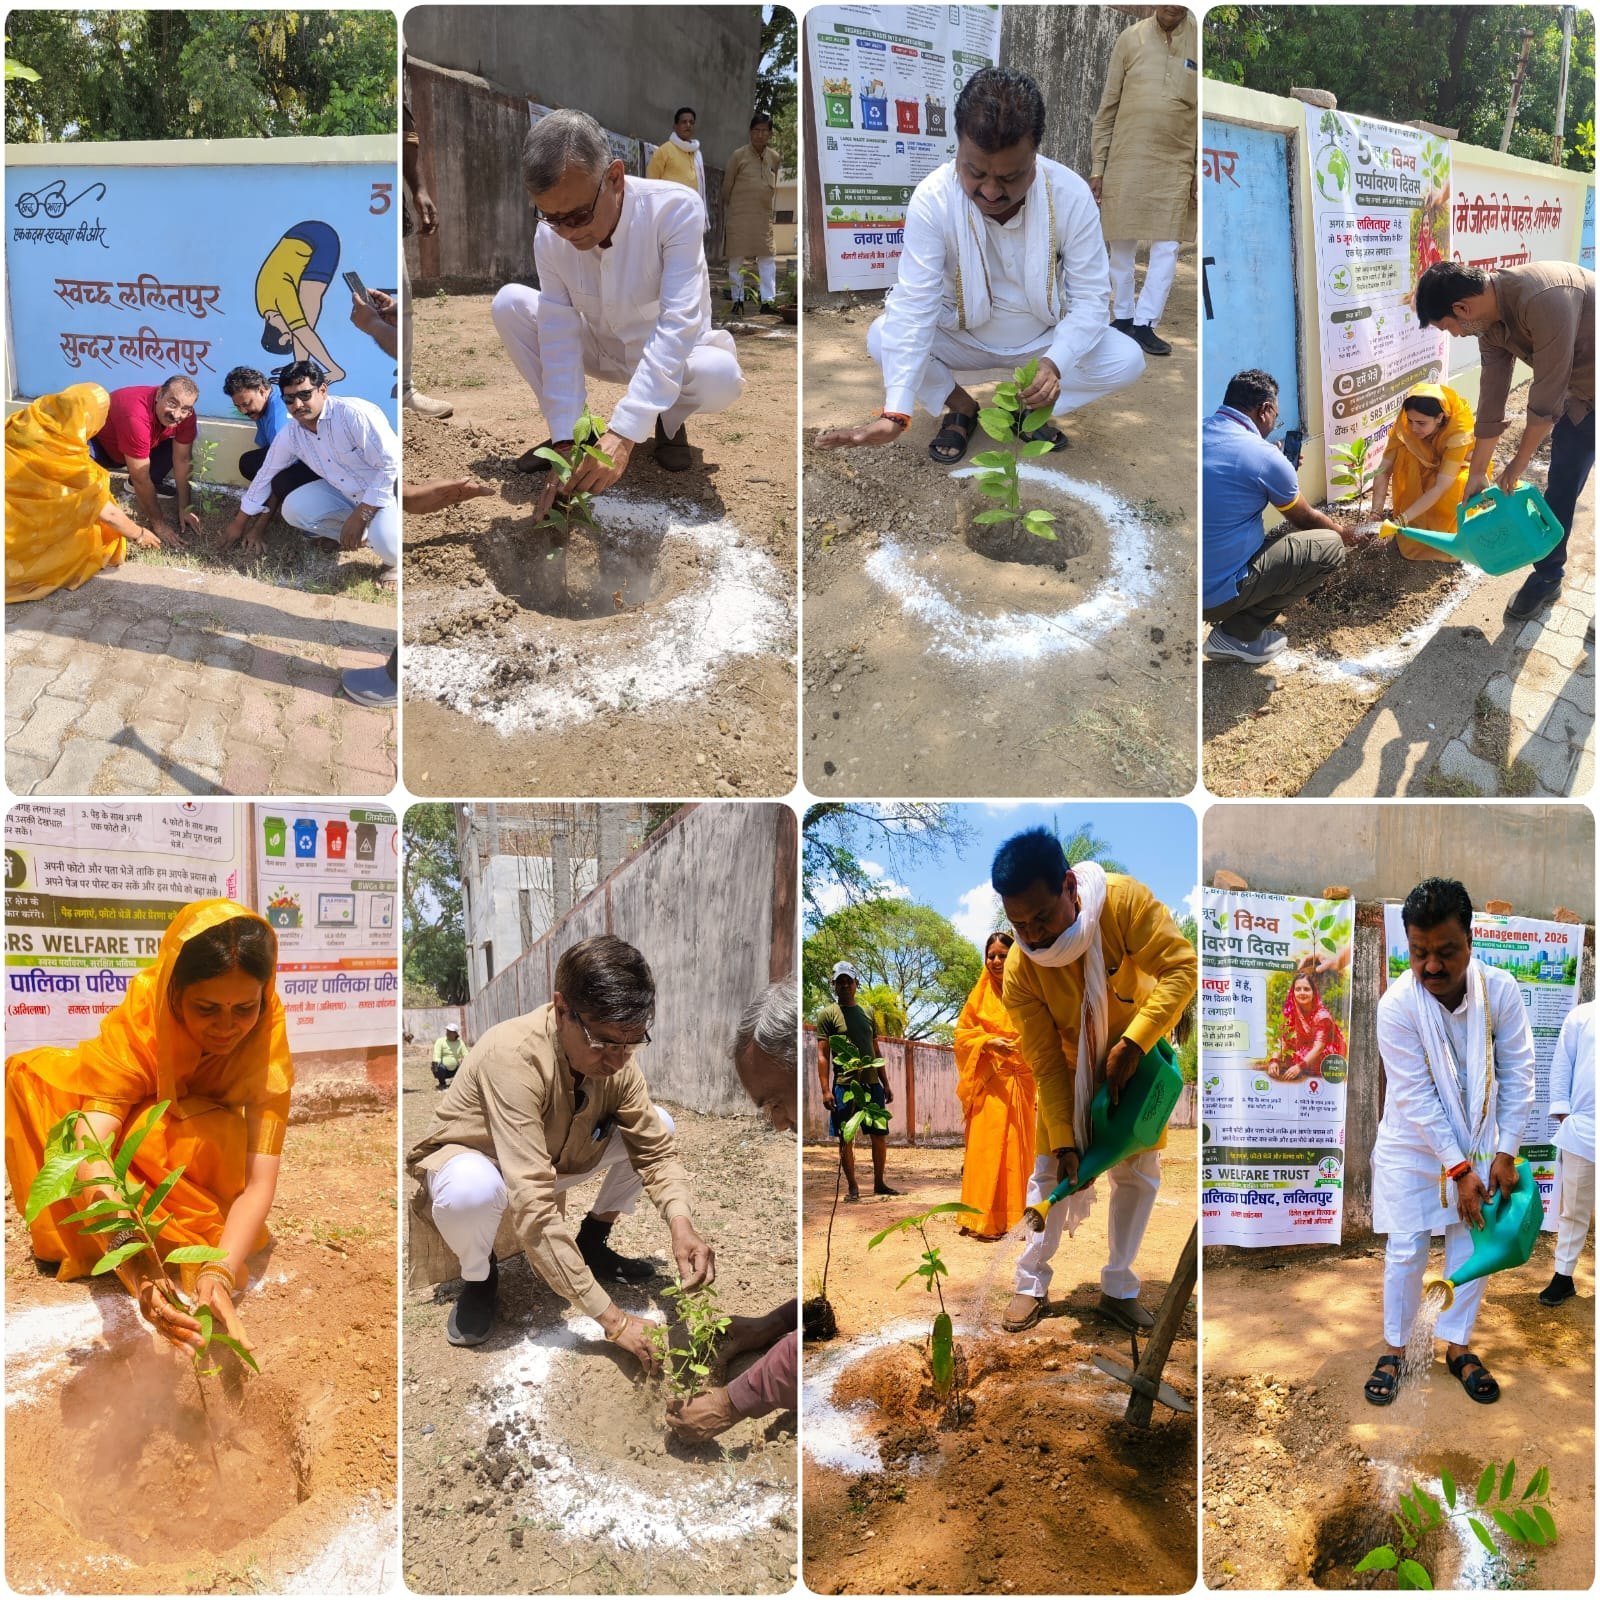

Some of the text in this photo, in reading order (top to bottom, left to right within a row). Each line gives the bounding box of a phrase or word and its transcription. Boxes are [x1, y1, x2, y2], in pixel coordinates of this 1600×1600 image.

[1391, 147, 1416, 172] विश्व
[1355, 169, 1421, 194] पर्यावरण दिवस
[1329, 219, 1344, 229] अगर
[1356, 216, 1391, 233] ललितपुर
[1469, 192, 1500, 235] जीतने
[1501, 193, 1512, 233] से
[1511, 195, 1533, 240] पहले
[853, 232, 883, 245] नगर
[1336, 234, 1342, 244] 5
[53, 273, 225, 319] स्वच्छ ललितपुर
[60, 326, 216, 375] सुन्दर ललितपुर
[1370, 408, 1383, 422] SRS
[15, 815, 36, 825] उसकी
[37, 817, 63, 829] देखभाल
[82, 811, 89, 819] 3.
[101, 810, 109, 819] के
[110, 812, 124, 821] साथ
[126, 813, 143, 822] अपनी
[90, 823, 102, 831] एक
[103, 822, 119, 833] फोटो
[44, 860, 217, 883] अपनी फोटो और पता भेजें ताकि हम आपके प्रयास को
[45, 876, 63, 887] अपने
[65, 876, 78, 888] पेज
[80, 879, 90, 889] पर
[92, 877, 109, 889] पोस्ट
[111, 881, 123, 890] कर
[142, 880, 155, 891] और
[157, 882, 168, 892] इस
[170, 882, 183, 893] पौधे
[184, 884, 193, 895] को
[29, 896, 39, 906] के
[1234, 909, 1280, 934] विश्व
[5, 933, 161, 955] RS WELFARE TR
[1474, 927, 1568, 944] Management, 2026
[1247, 934, 1290, 956] दिवस
[9, 968, 134, 993] पालिका परिष
[284, 979, 318, 995] नगर
[322, 973, 371, 994] पालिका
[1241, 994, 1253, 1004] दिन
[67, 1004, 91, 1015] समस्त
[1218, 1168, 1310, 1181] WELFARE TRUST
[1202, 1188, 1333, 1206] ालिका परिषद, ललितपुर
